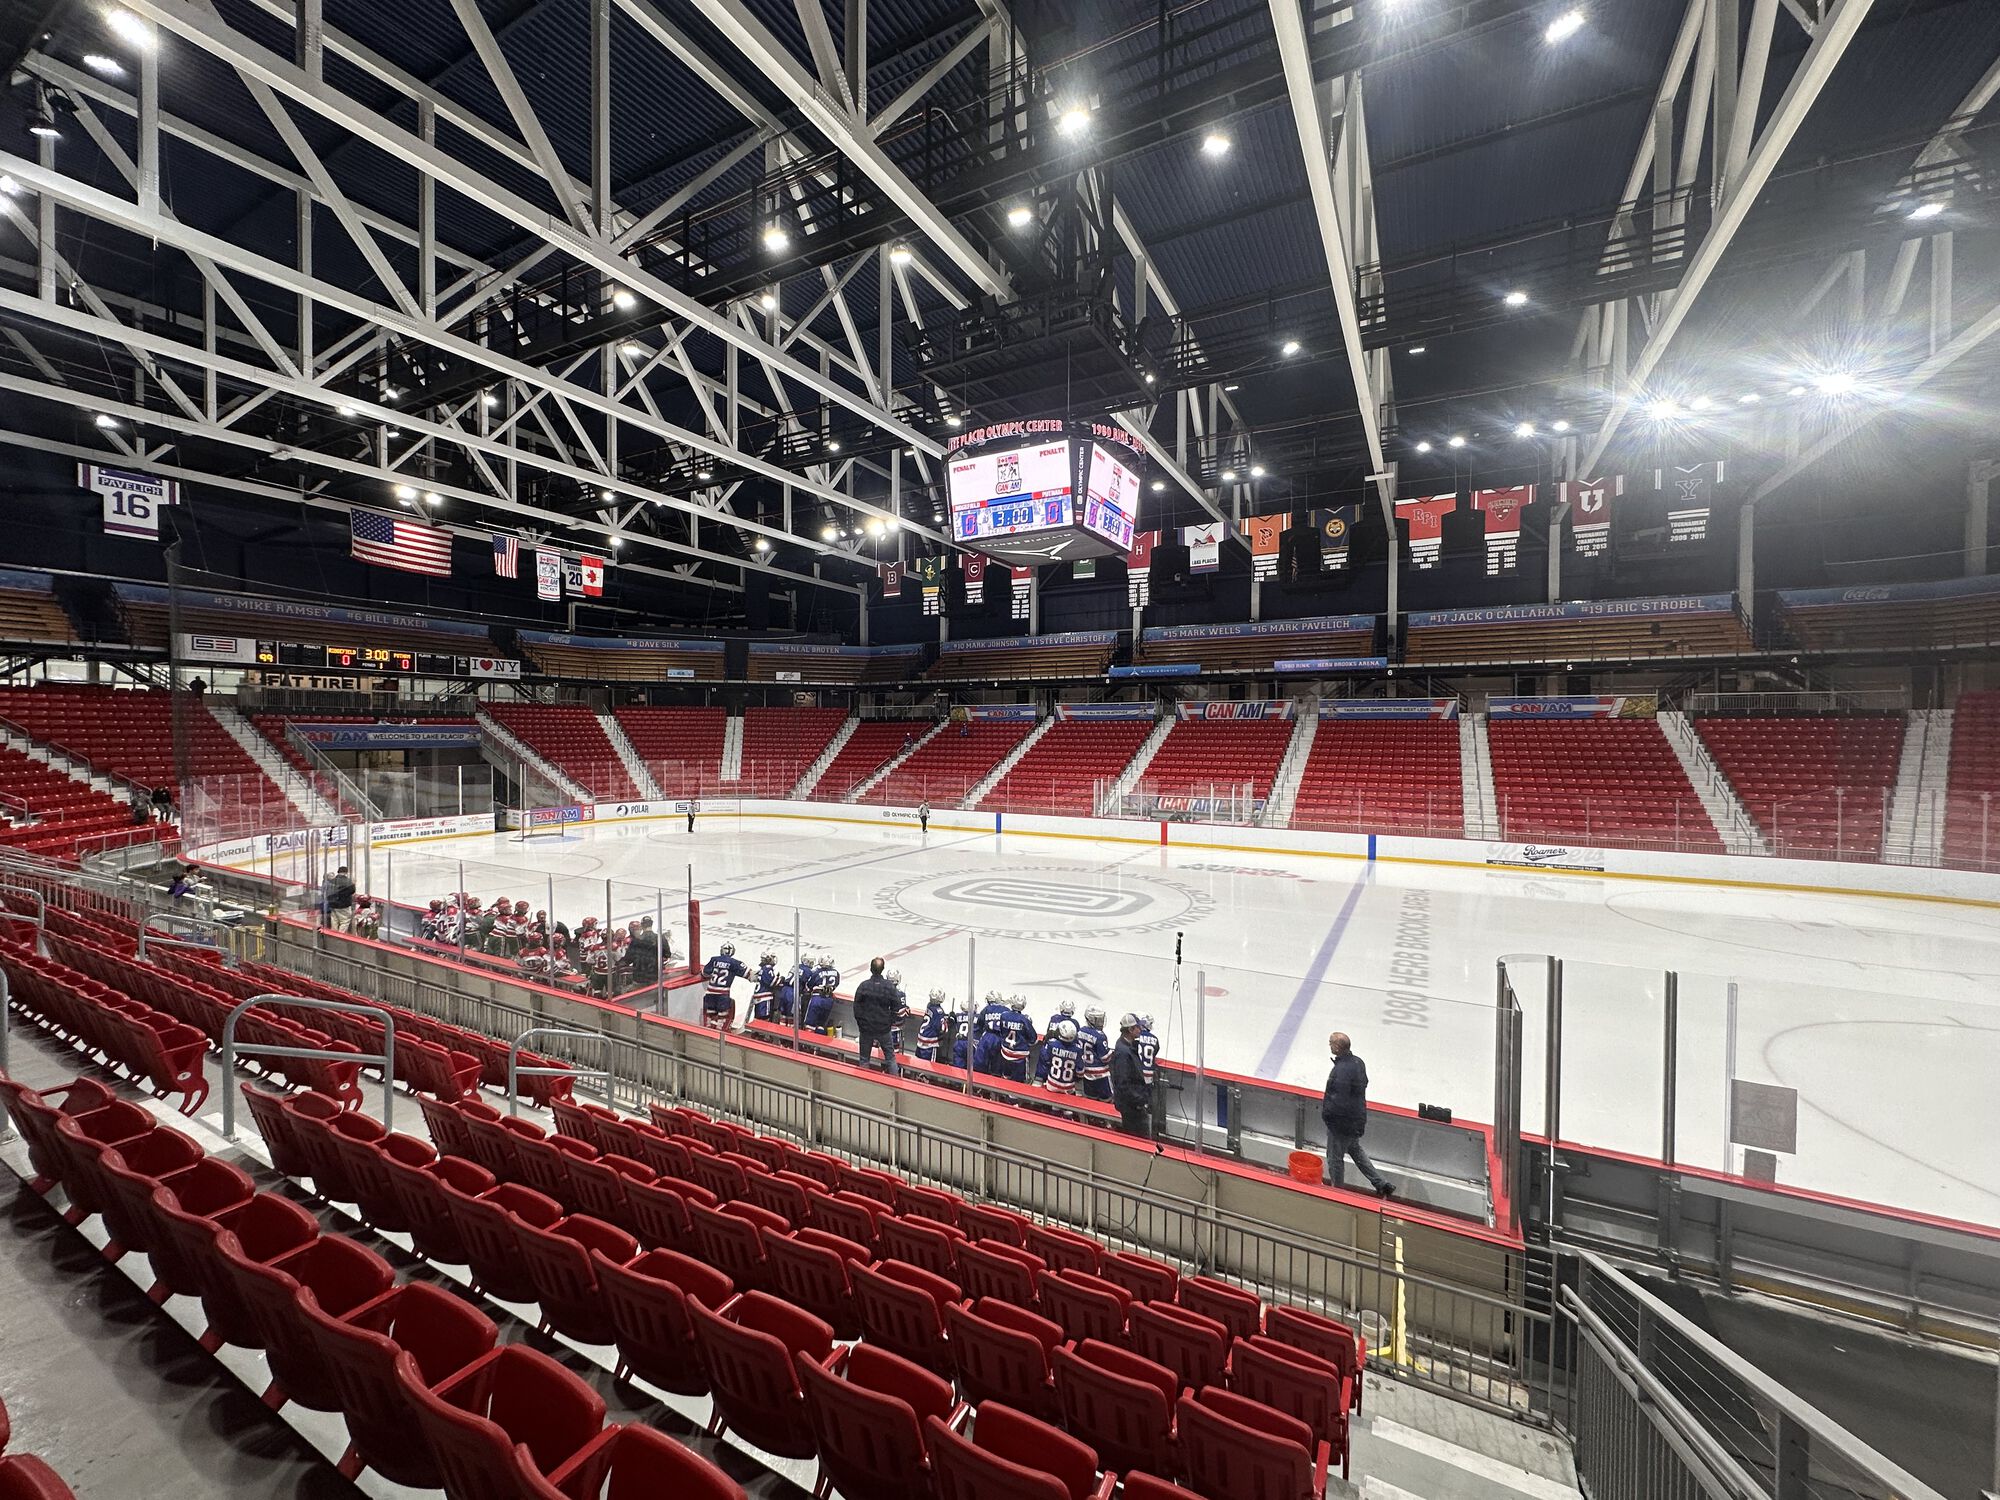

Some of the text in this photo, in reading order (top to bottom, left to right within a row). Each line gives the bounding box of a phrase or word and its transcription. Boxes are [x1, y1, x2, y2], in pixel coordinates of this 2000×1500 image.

[986, 421, 1025, 440] OLYMPIC
[1026, 420, 1063, 432] CENTER
[1091, 424, 1111, 438] 1980
[1039, 447, 1065, 457] PENALTY
[953, 464, 976, 473] PENALTY
[101, 477, 162, 496] PAVELICH
[1675, 479, 1702, 500] Y
[112, 490, 150, 519] 16
[996, 507, 1029, 526] 3:00
[1047, 502, 1059, 524] 0
[1413, 508, 1438, 528] RPI
[965, 514, 976, 536] 0
[1670, 520, 1706, 528] TOURNAMENT
[1575, 531, 1608, 539] TOURNAMENT
[1672, 526, 1705, 534] CHAMPIONS
[1577, 537, 1607, 545] CHAMPIONS
[1670, 534, 1687, 542] 2009
[1136, 545, 1142, 556] H
[971, 564, 979, 574] C
[569, 572, 582, 586] 20
[888, 571, 897, 584] B
[214, 597, 332, 618] #5 MIKE RAMSEY
[1581, 599, 1705, 614] #19 ERIC STROBEL
[346, 612, 428, 628] #6 BILL BAKER
[1430, 614, 1447, 622] #17
[1450, 612, 1482, 622] JACK
[1251, 619, 1350, 633] #16 MARK PAVELICH
[1163, 626, 1241, 638] #15 MARK WELLS
[639, 640, 659, 648] DAVE
[661, 641, 680, 649] SILK
[987, 640, 1020, 648] JOHNSON
[1039, 637, 1063, 645] STEVE
[1065, 634, 1107, 643] CHRISTOFF
[366, 649, 388, 660] 3:00
[811, 646, 840, 654] BROTEN
[259, 653, 273, 662] 99
[342, 655, 350, 665] 0
[402, 660, 409, 669] 0
[494, 661, 519, 672] NY
[309, 676, 356, 690] TIRE
[1510, 703, 1573, 714] CAN/AM
[631, 805, 649, 814] POLAR
[1523, 845, 1567, 856] Roamers
[1381, 889, 1431, 1029] 1980 HERB BROOKS ARENA
[1005, 1030, 1017, 1048] 4
[1052, 1046, 1078, 1060] CLINTON
[1050, 1056, 1076, 1081] 88
